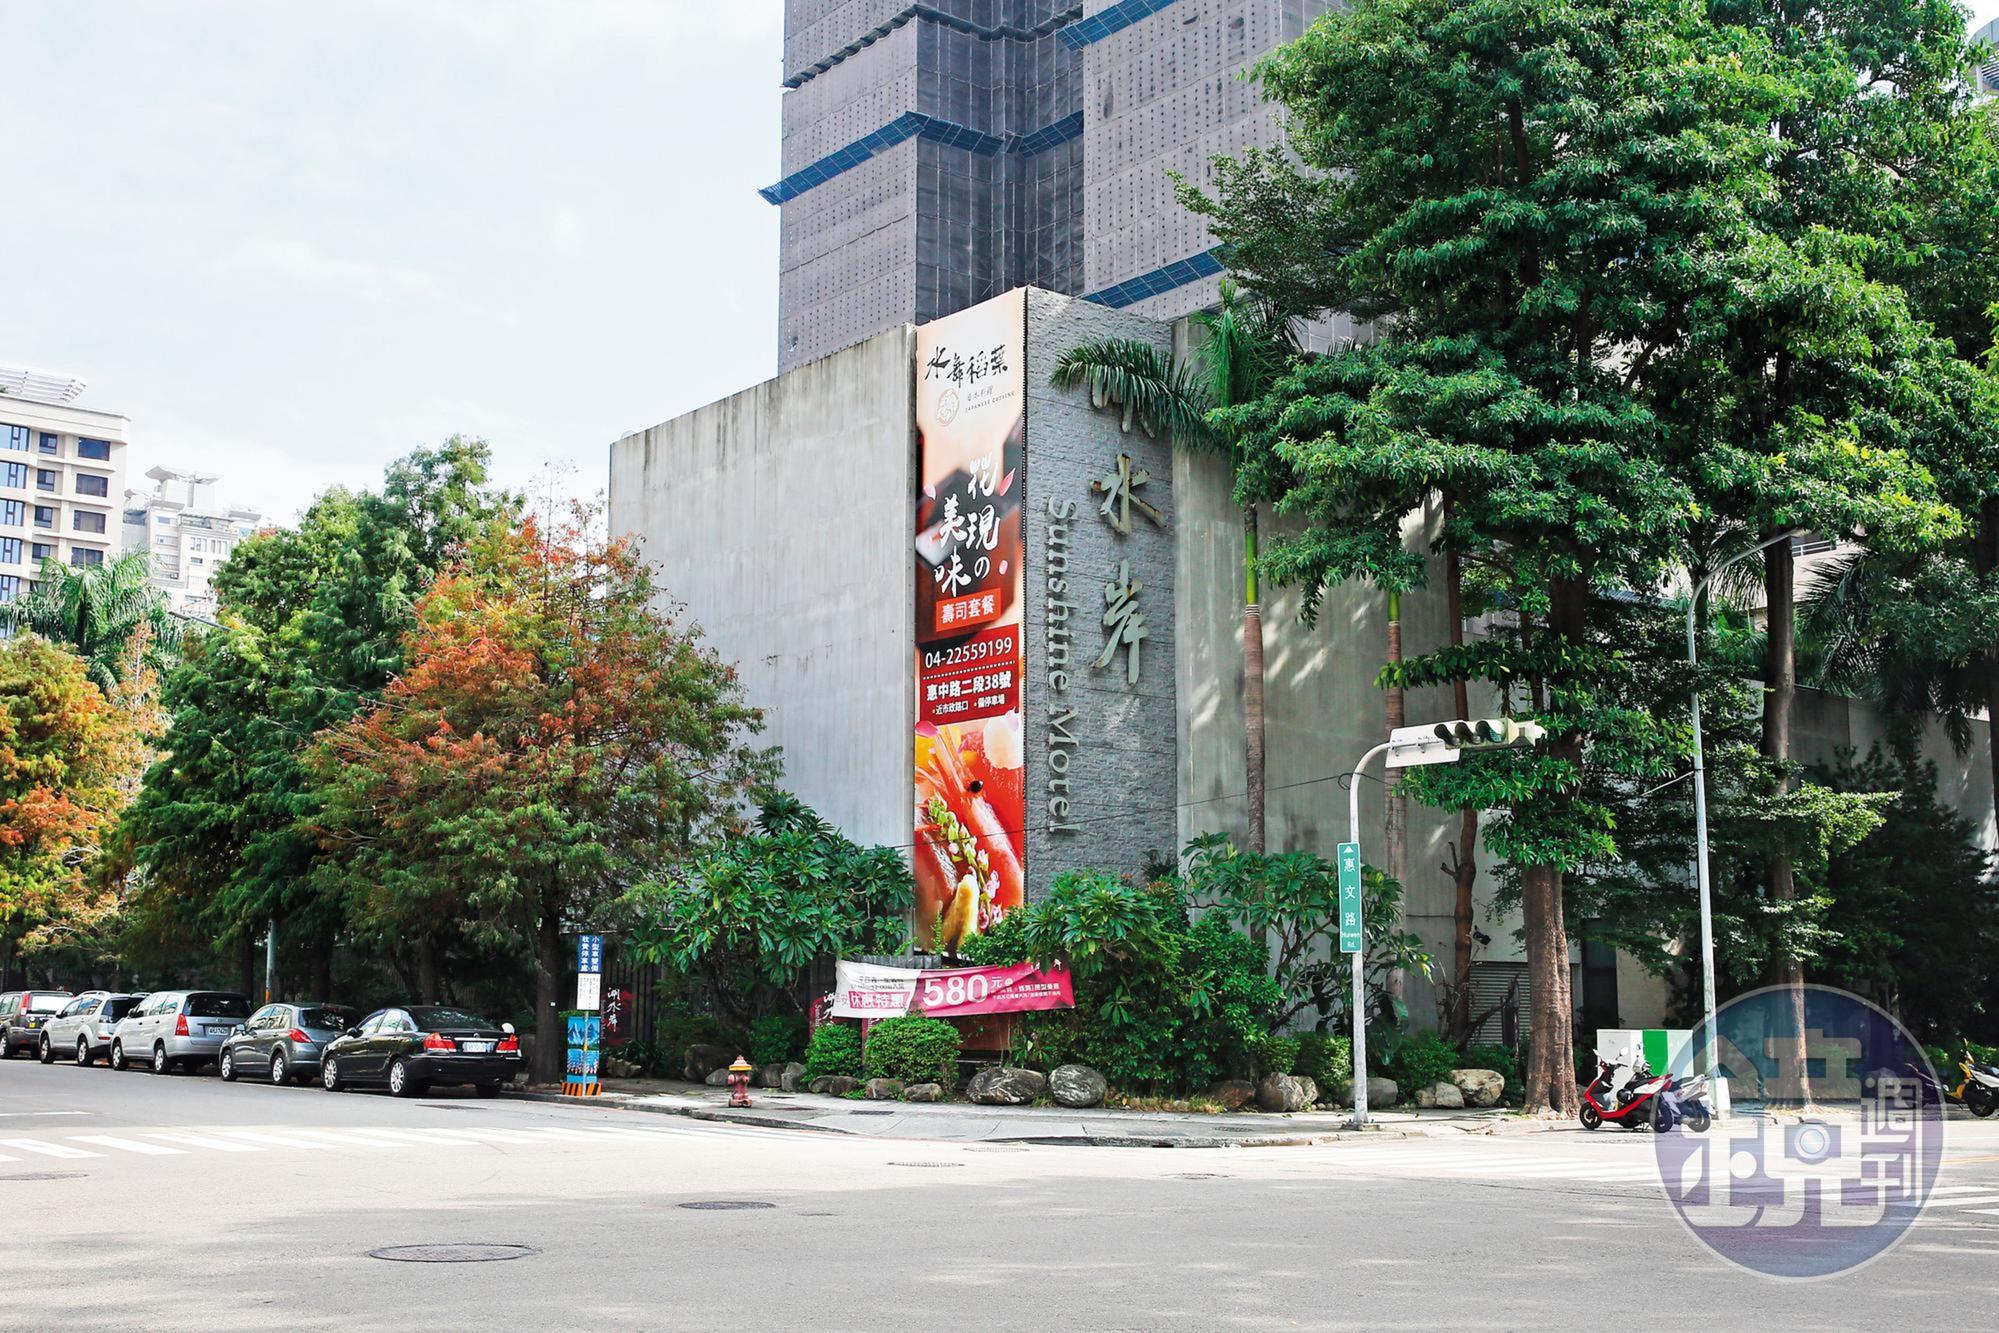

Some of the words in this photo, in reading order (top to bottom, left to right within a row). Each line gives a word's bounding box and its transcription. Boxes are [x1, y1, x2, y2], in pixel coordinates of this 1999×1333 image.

[941, 594, 996, 625] 壽司套餐
[1047, 496, 1080, 691] Sunshine
[1090, 453, 1167, 687] 水岸
[925, 636, 1013, 669] 04-22559199
[1047, 707, 1081, 834] Motel
[1343, 858, 1356, 927] 惠文路
